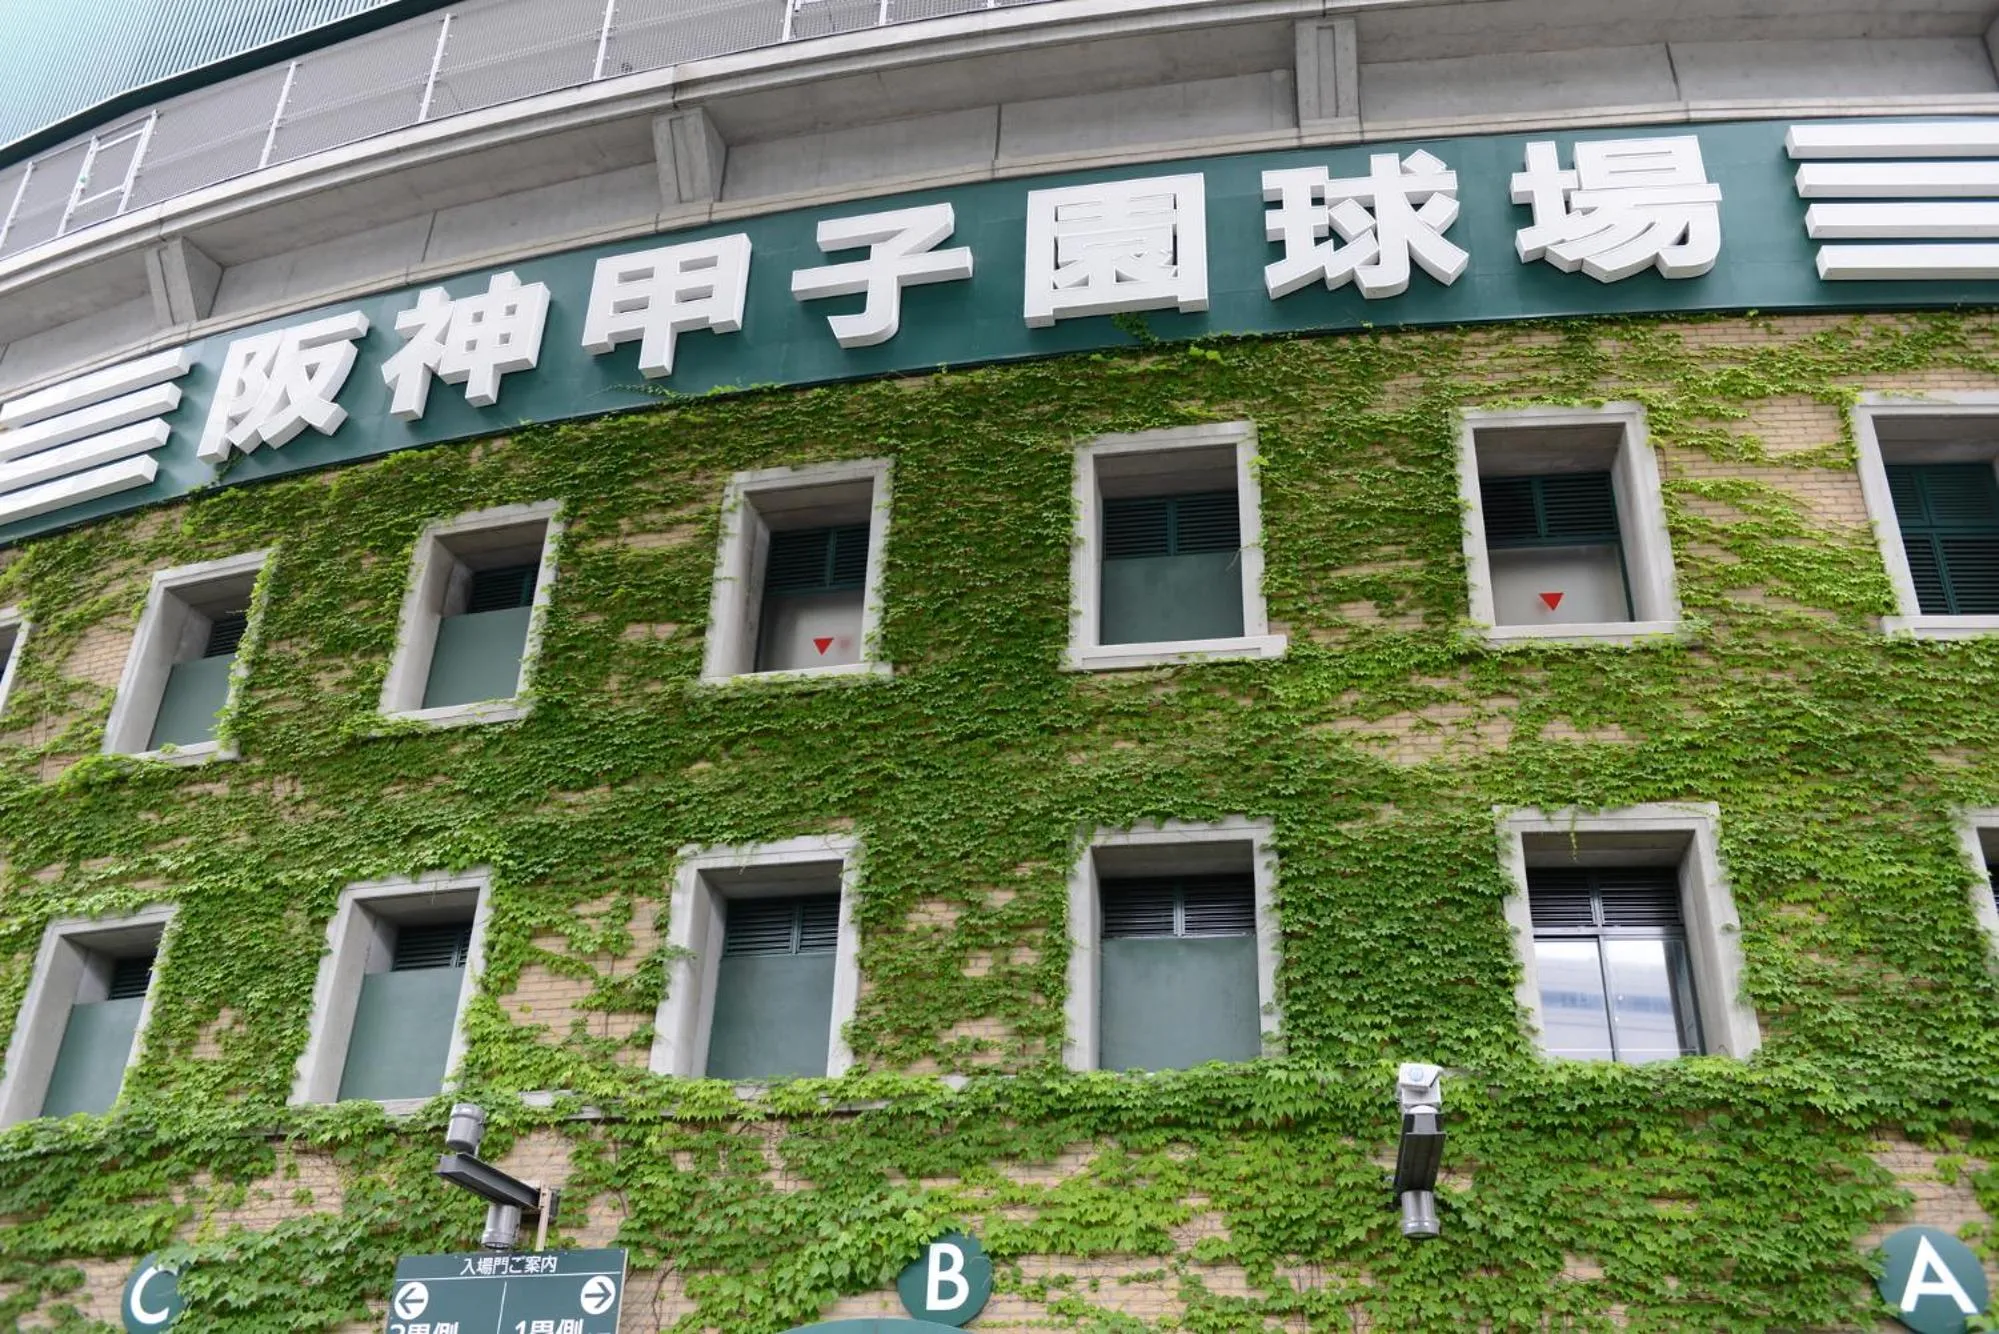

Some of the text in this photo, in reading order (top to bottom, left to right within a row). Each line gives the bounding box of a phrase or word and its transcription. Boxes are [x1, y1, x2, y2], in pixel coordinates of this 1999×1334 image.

[197, 135, 1723, 463] 阪神甲子園球場
[130, 1264, 178, 1325] C
[459, 1256, 558, 1276] 入場門ご案内
[926, 1243, 970, 1311] B
[1900, 1235, 1979, 1314] A
